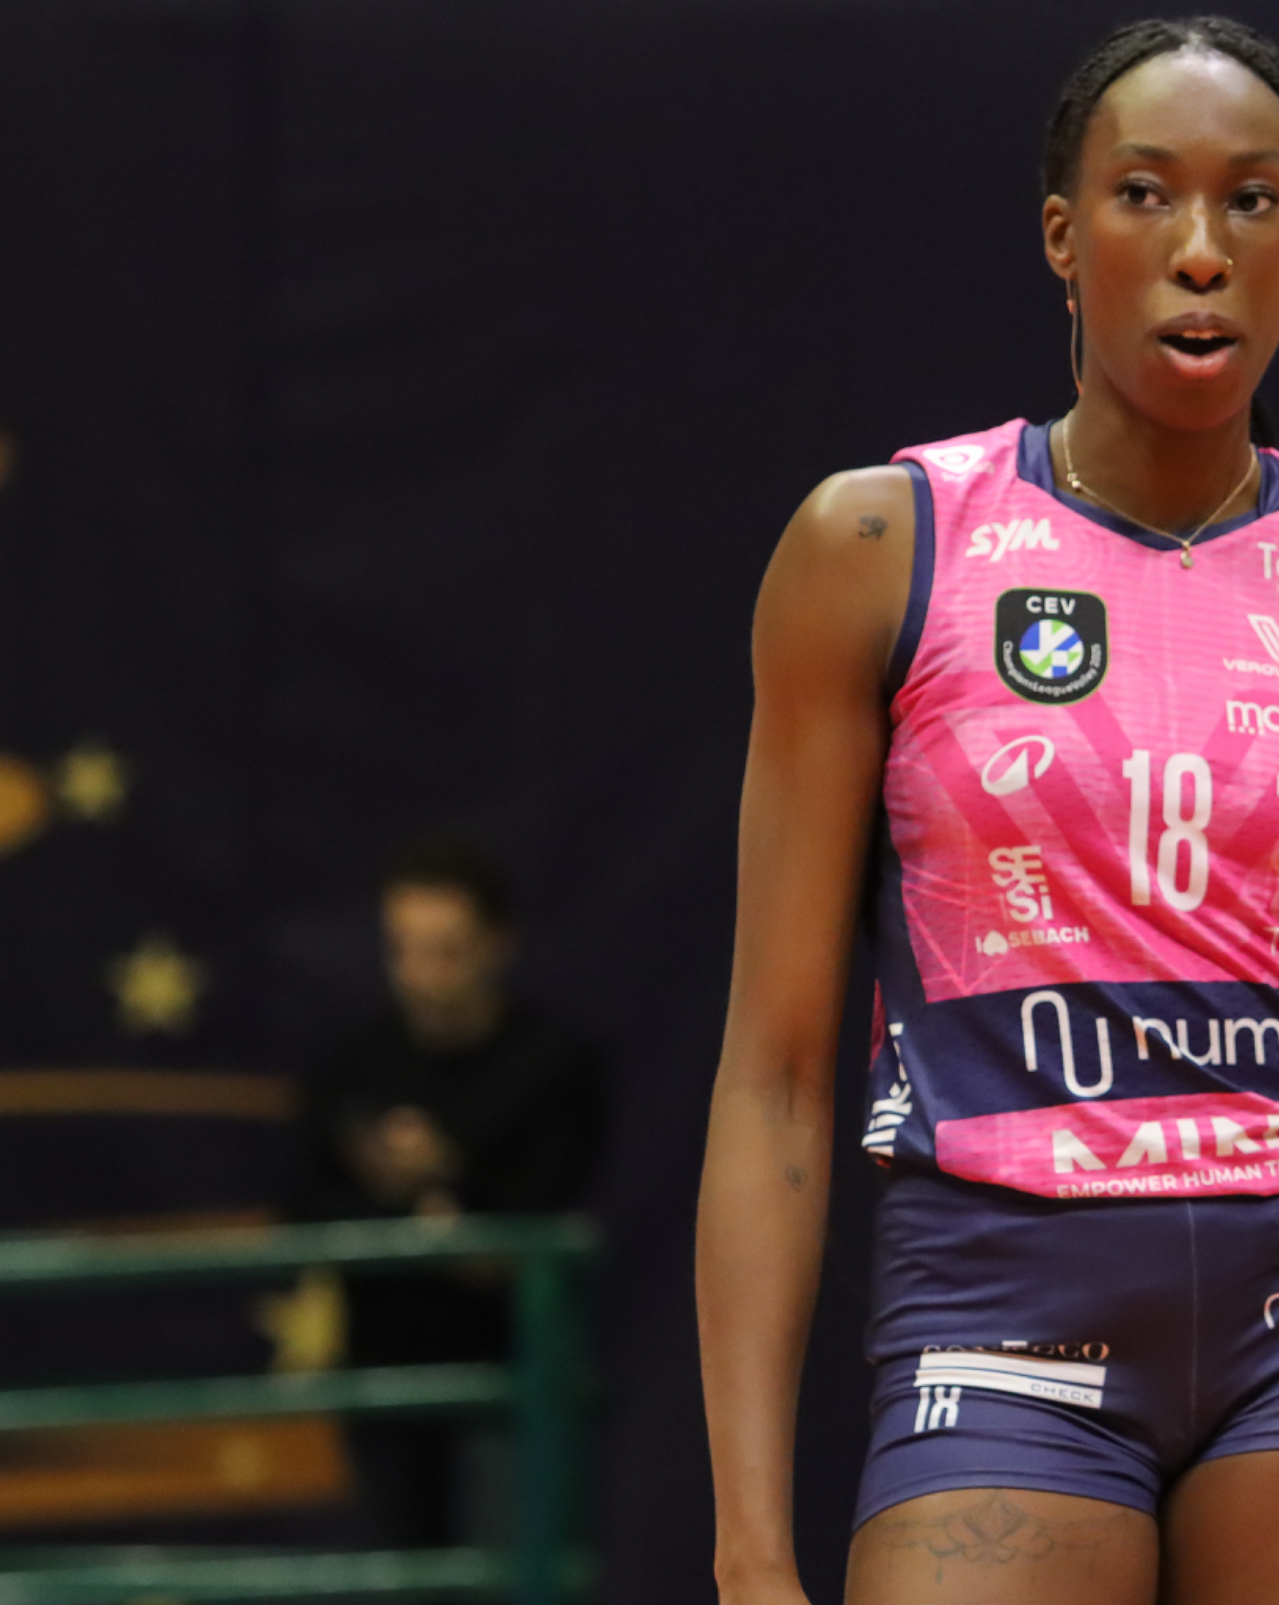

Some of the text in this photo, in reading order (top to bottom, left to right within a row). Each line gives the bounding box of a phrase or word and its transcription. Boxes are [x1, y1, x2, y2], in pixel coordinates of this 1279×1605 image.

[965, 518, 1060, 562] SYM
[1026, 595, 1076, 615] CEV
[1122, 749, 1212, 912] 18
[988, 846, 1046, 887] SE
[1008, 926, 1089, 949] SEBACH
[1056, 1174, 1177, 1198] EMPOWER
[1184, 1162, 1263, 1187] HUMAN
[1029, 1383, 1095, 1403] CHECK
